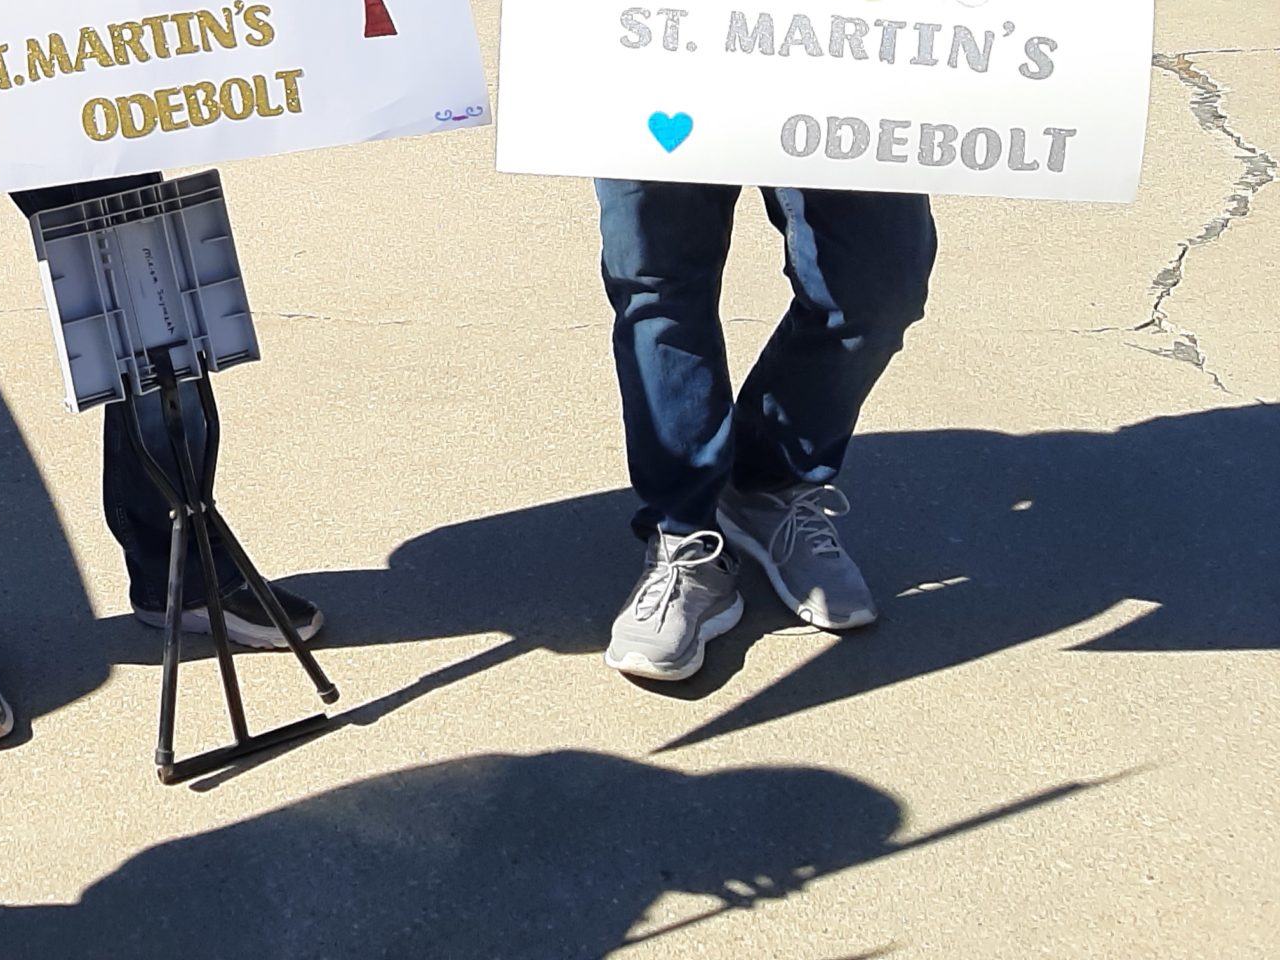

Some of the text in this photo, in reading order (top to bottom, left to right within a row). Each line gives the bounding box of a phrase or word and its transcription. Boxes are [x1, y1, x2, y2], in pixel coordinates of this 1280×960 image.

[620, 7, 1058, 81] ST. MARTIN'S
[81, 68, 305, 142] ODEBOLT
[779, 113, 1077, 173] ODEBOLT
